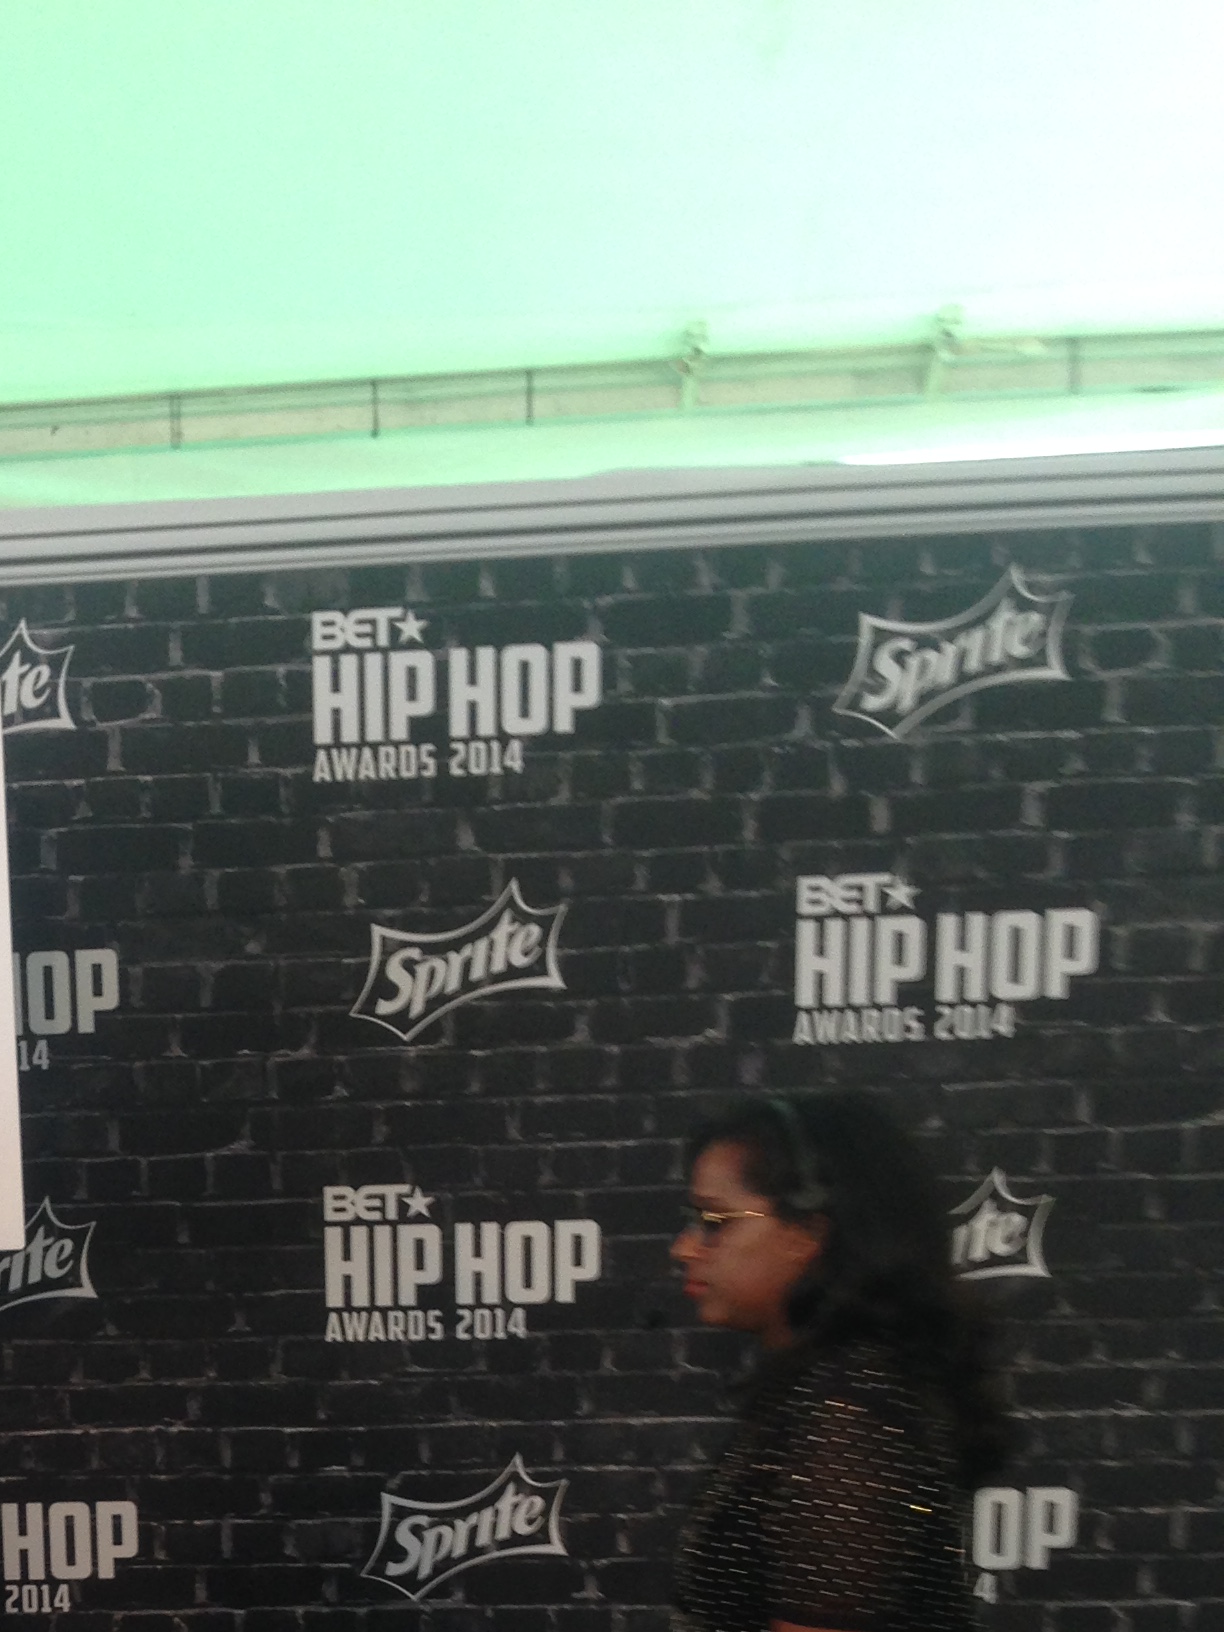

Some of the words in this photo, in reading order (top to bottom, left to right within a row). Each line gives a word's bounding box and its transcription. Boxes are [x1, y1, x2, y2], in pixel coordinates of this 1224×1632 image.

[311, 606, 405, 650] BET
[859, 598, 1047, 716] Sprite
[312, 649, 438, 746] HIP
[447, 640, 604, 740] HOP
[312, 743, 438, 784] AWARDS
[447, 738, 526, 778] 2014
[794, 871, 895, 917] BET
[374, 907, 544, 1020] Sprite
[794, 913, 927, 1010] HIP
[934, 906, 1101, 1005] HOP
[17, 1038, 51, 1072] 14
[792, 1005, 927, 1046] AWARDS
[933, 1002, 1017, 1042] 2014
[322, 1183, 413, 1222] BET
[323, 1223, 444, 1308] HIP
[453, 1218, 603, 1306] HOP
[324, 1309, 445, 1343] AWARDS
[454, 1307, 527, 1341] 2014
[0, 1500, 140, 1581] HOP
[385, 1480, 546, 1581] Sprite
[972, 1486, 1080, 1571] OP
[4, 1583, 72, 1614] 2014
